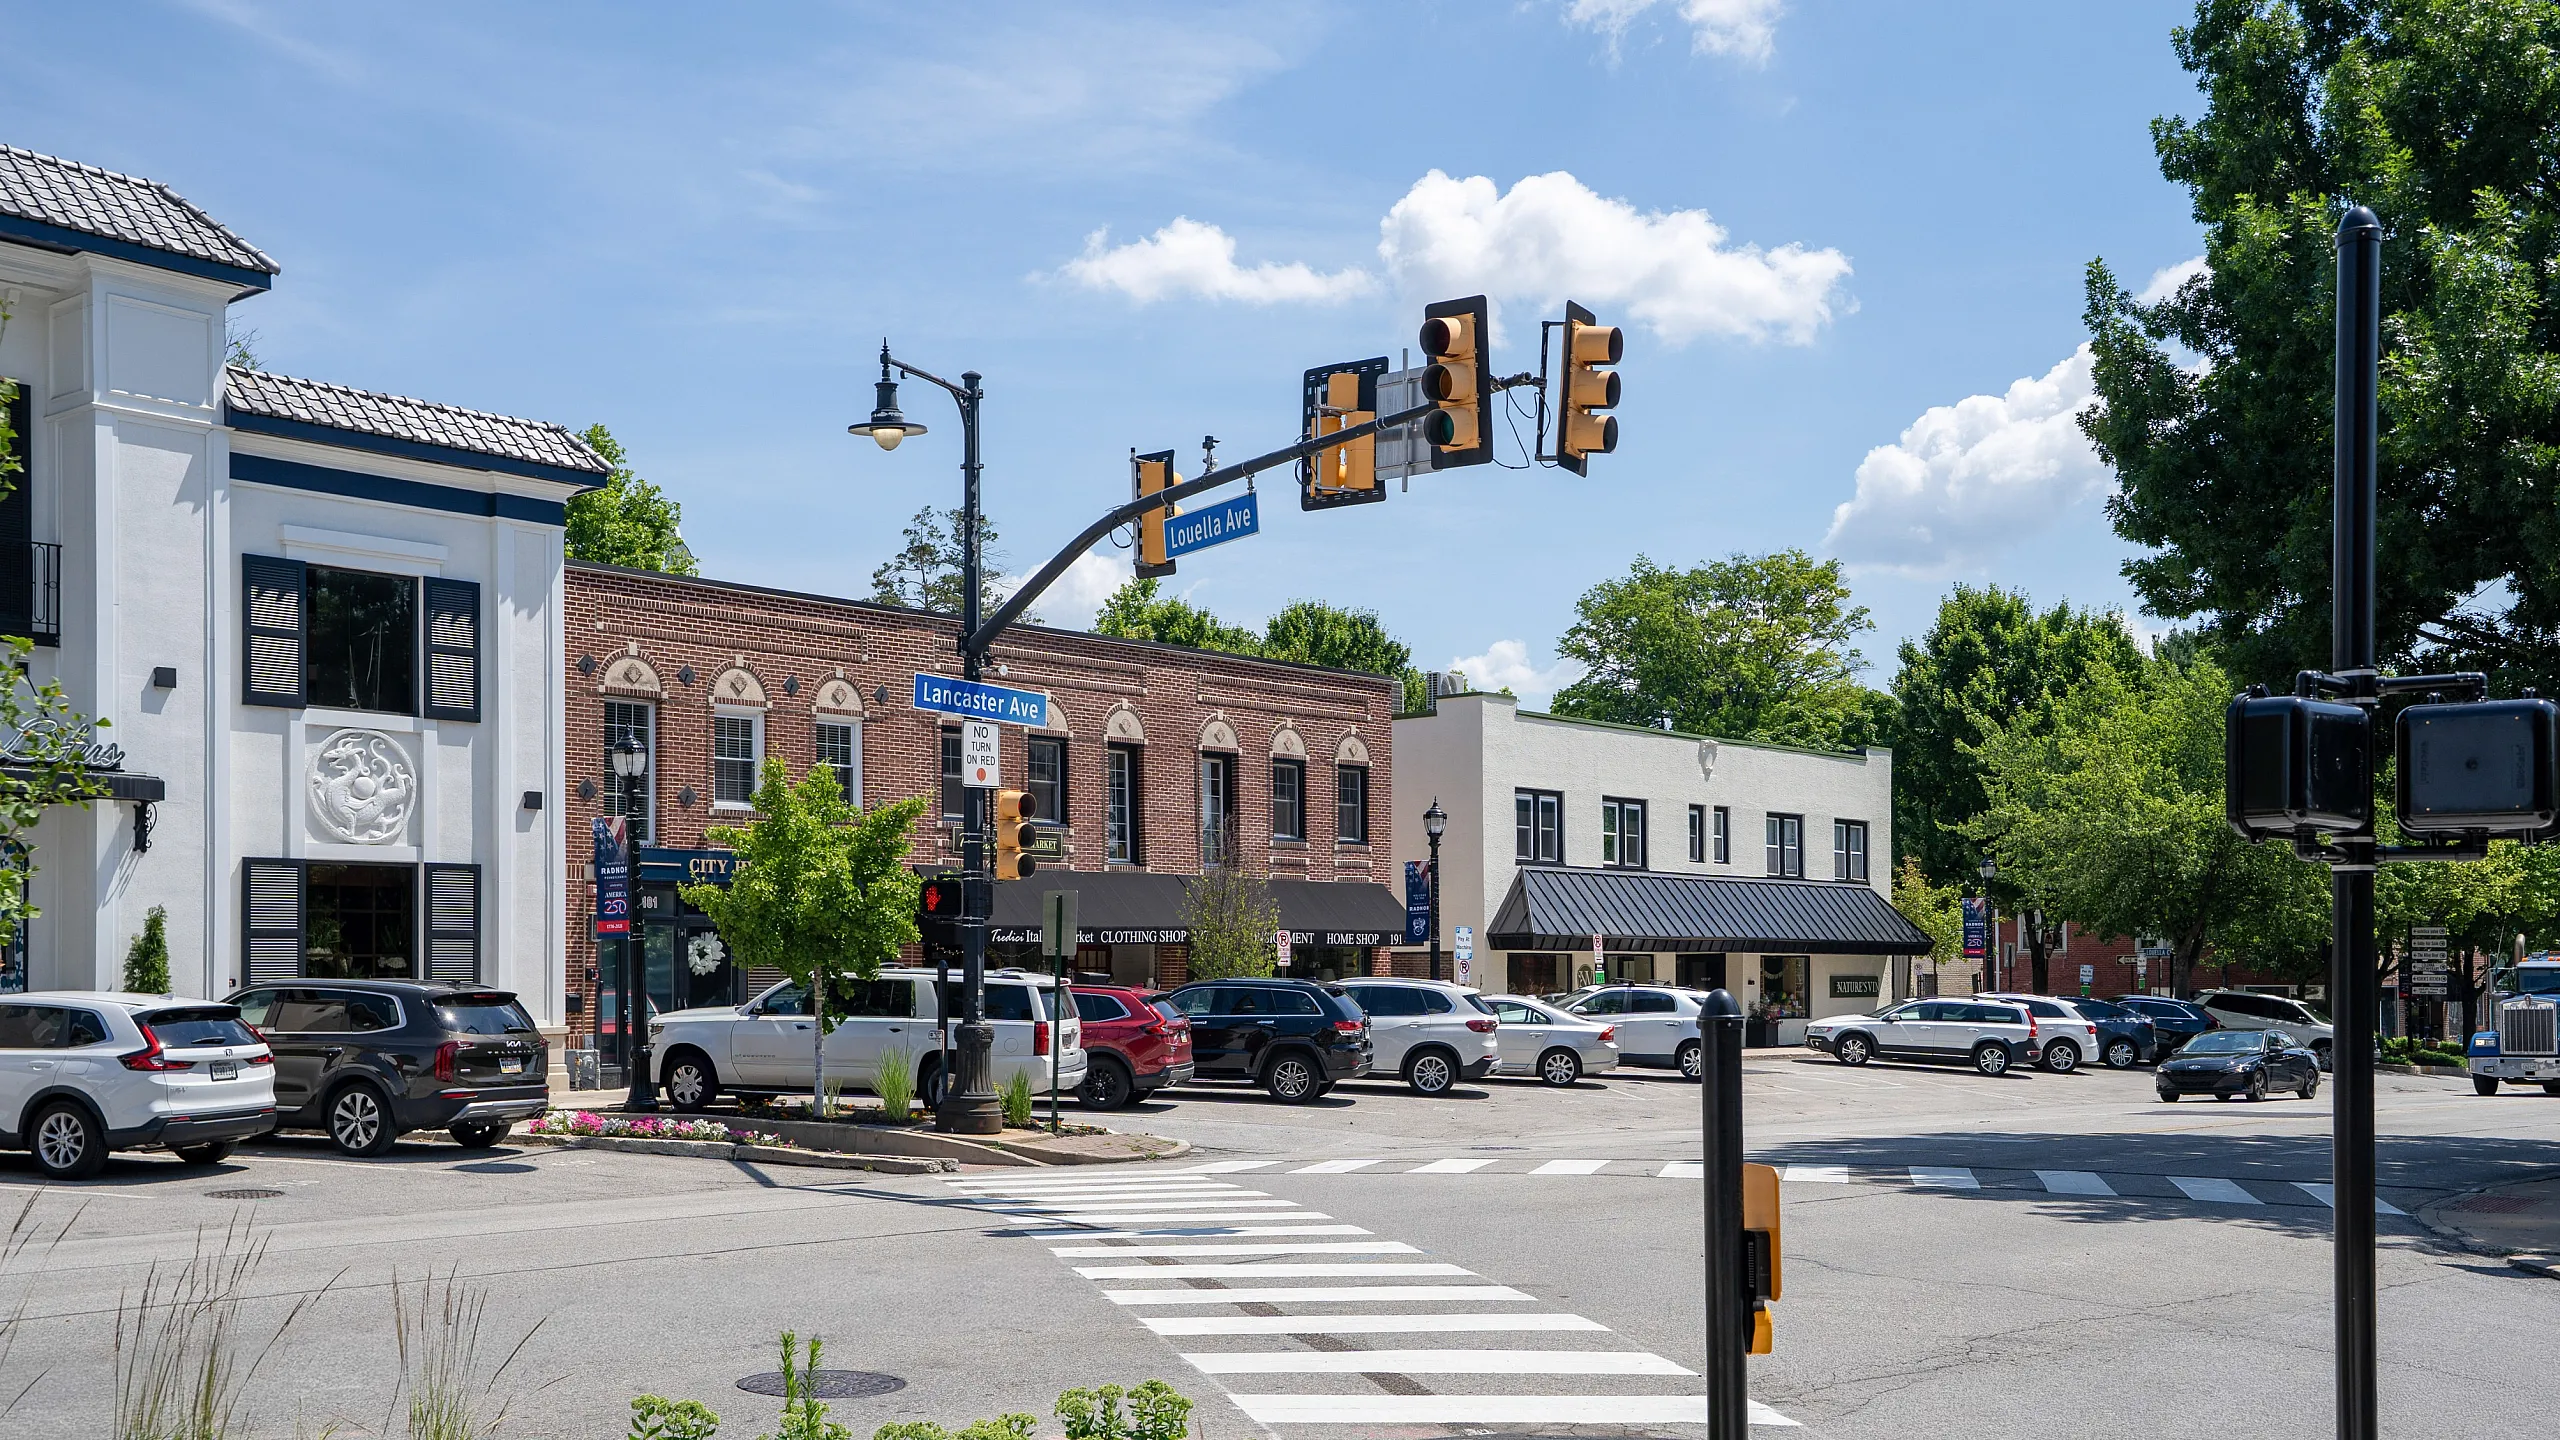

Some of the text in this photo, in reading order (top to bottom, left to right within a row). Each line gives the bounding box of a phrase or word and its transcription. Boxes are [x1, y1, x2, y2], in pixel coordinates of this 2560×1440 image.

[1170, 508, 1251, 549] Louella Ave
[923, 682, 1038, 719] Lancaster Ave
[973, 726, 988, 738] NO
[971, 741, 991, 752] TURN
[966, 754, 996, 765] ON RED
[689, 859, 728, 874] CITY
[604, 891, 627, 899] AMERICA
[604, 899, 627, 914] 250
[991, 928, 1025, 943] Tredici
[1100, 930, 1157, 943] CLOTHING
[1159, 930, 1187, 942] SHOP
[1326, 932, 1356, 944] HOME
[1356, 932, 1379, 945] SHOP
[1390, 934, 1402, 945] 191
